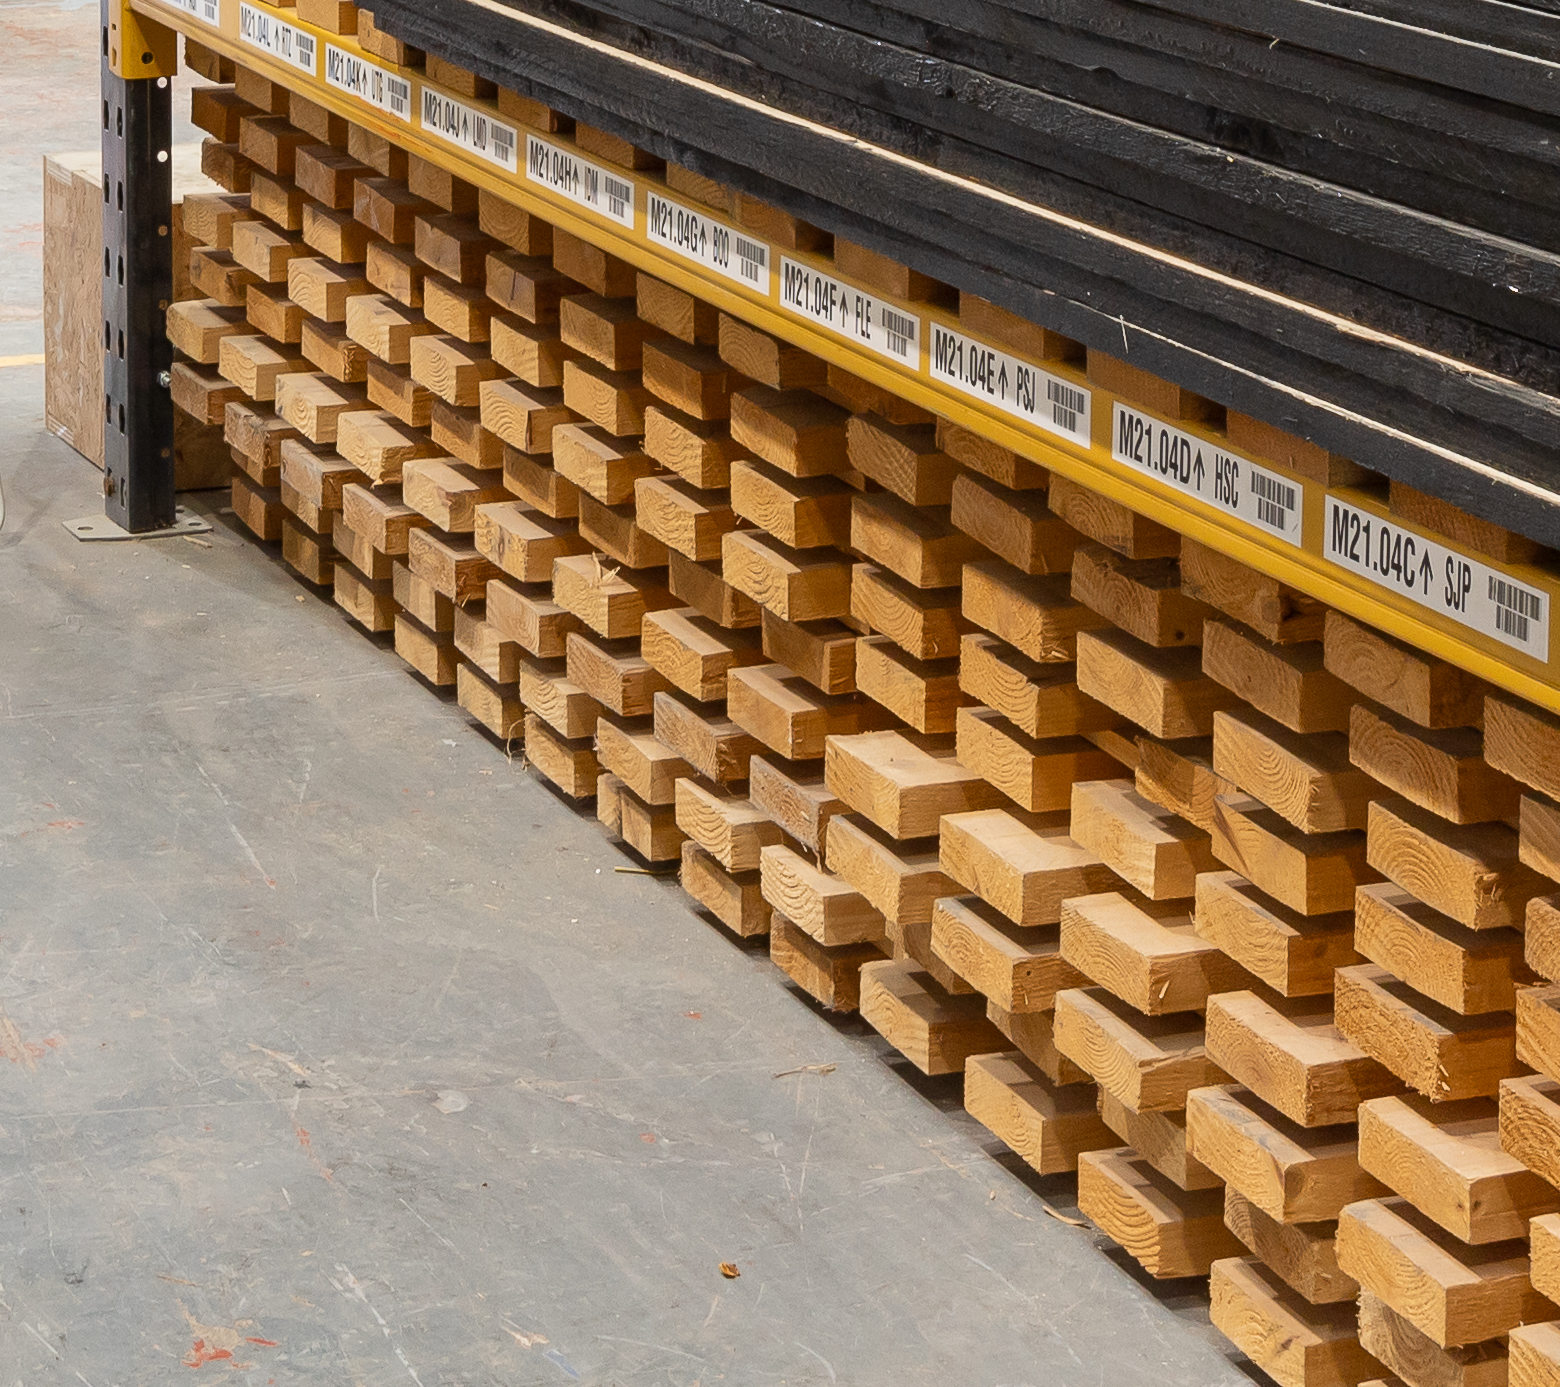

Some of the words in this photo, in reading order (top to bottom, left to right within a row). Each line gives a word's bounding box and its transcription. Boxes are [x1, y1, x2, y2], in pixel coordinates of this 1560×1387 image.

[241, 5, 271, 47] M21.04L
[328, 48, 361, 92] M21.04K
[424, 91, 460, 139] M21.04J
[530, 140, 572, 192] M21.04H
[650, 197, 698, 253] M21.04G
[784, 262, 837, 322] M21.04F
[855, 294, 872, 340] FLE
[934, 328, 997, 395] M21.04E
[1015, 362, 1036, 416] PSJ
[1119, 409, 1192, 486] M21.04D
[1214, 453, 1241, 510] HSC
[1331, 505, 1418, 589] M21.04C
[1444, 554, 1472, 613] SJP
